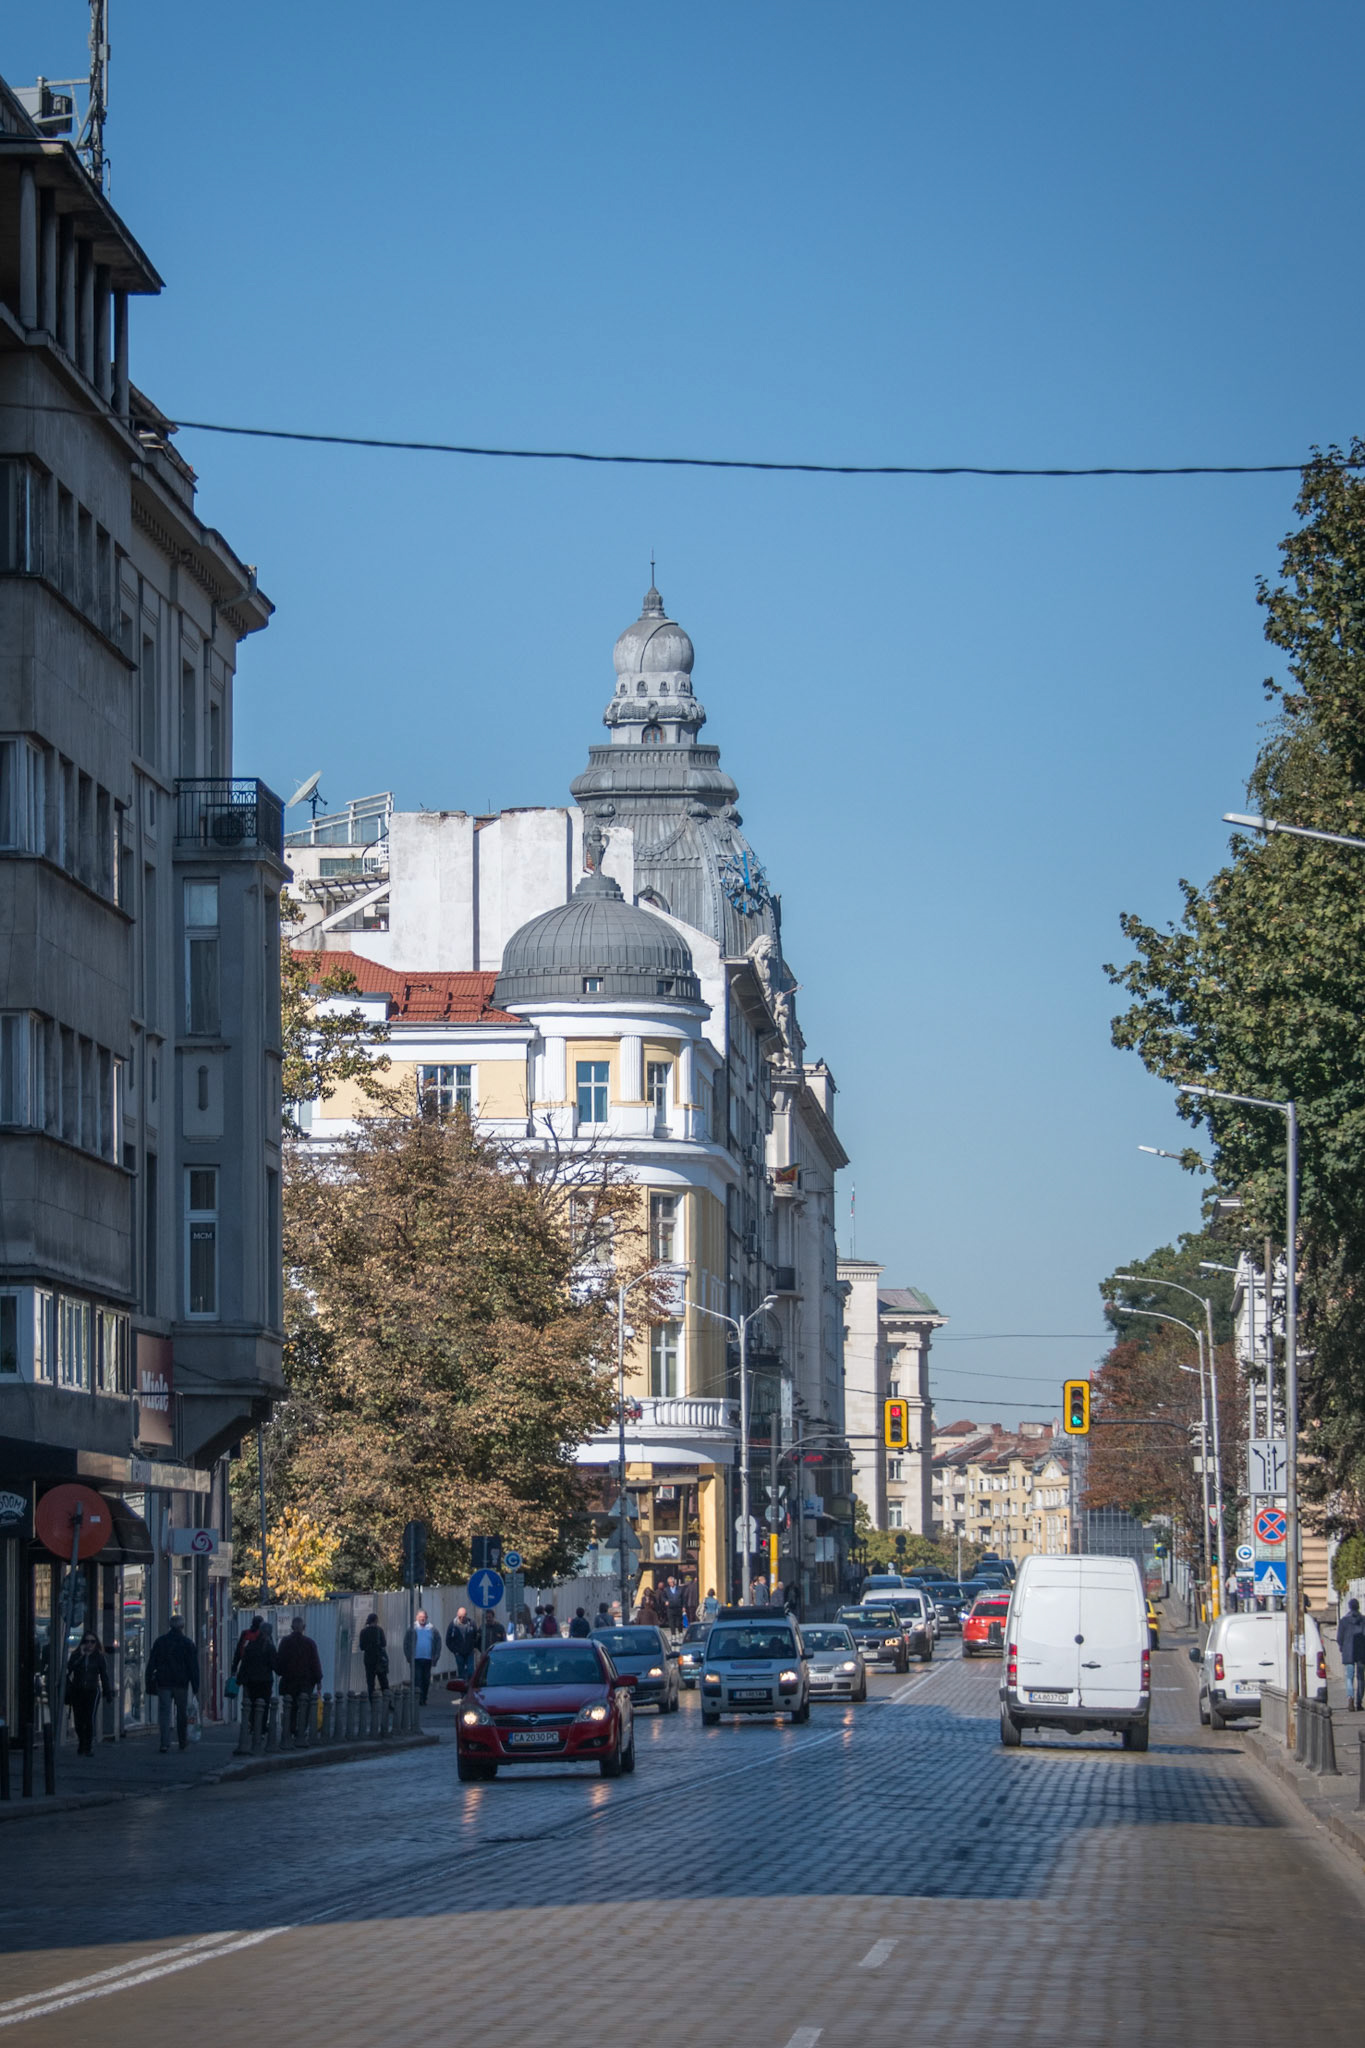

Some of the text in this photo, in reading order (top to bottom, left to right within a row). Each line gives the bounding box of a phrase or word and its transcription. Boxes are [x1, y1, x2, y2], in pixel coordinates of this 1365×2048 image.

[142, 1370, 169, 1412] Miele
[514, 1733, 525, 1742] CA
[526, 1733, 546, 1742] 2030
